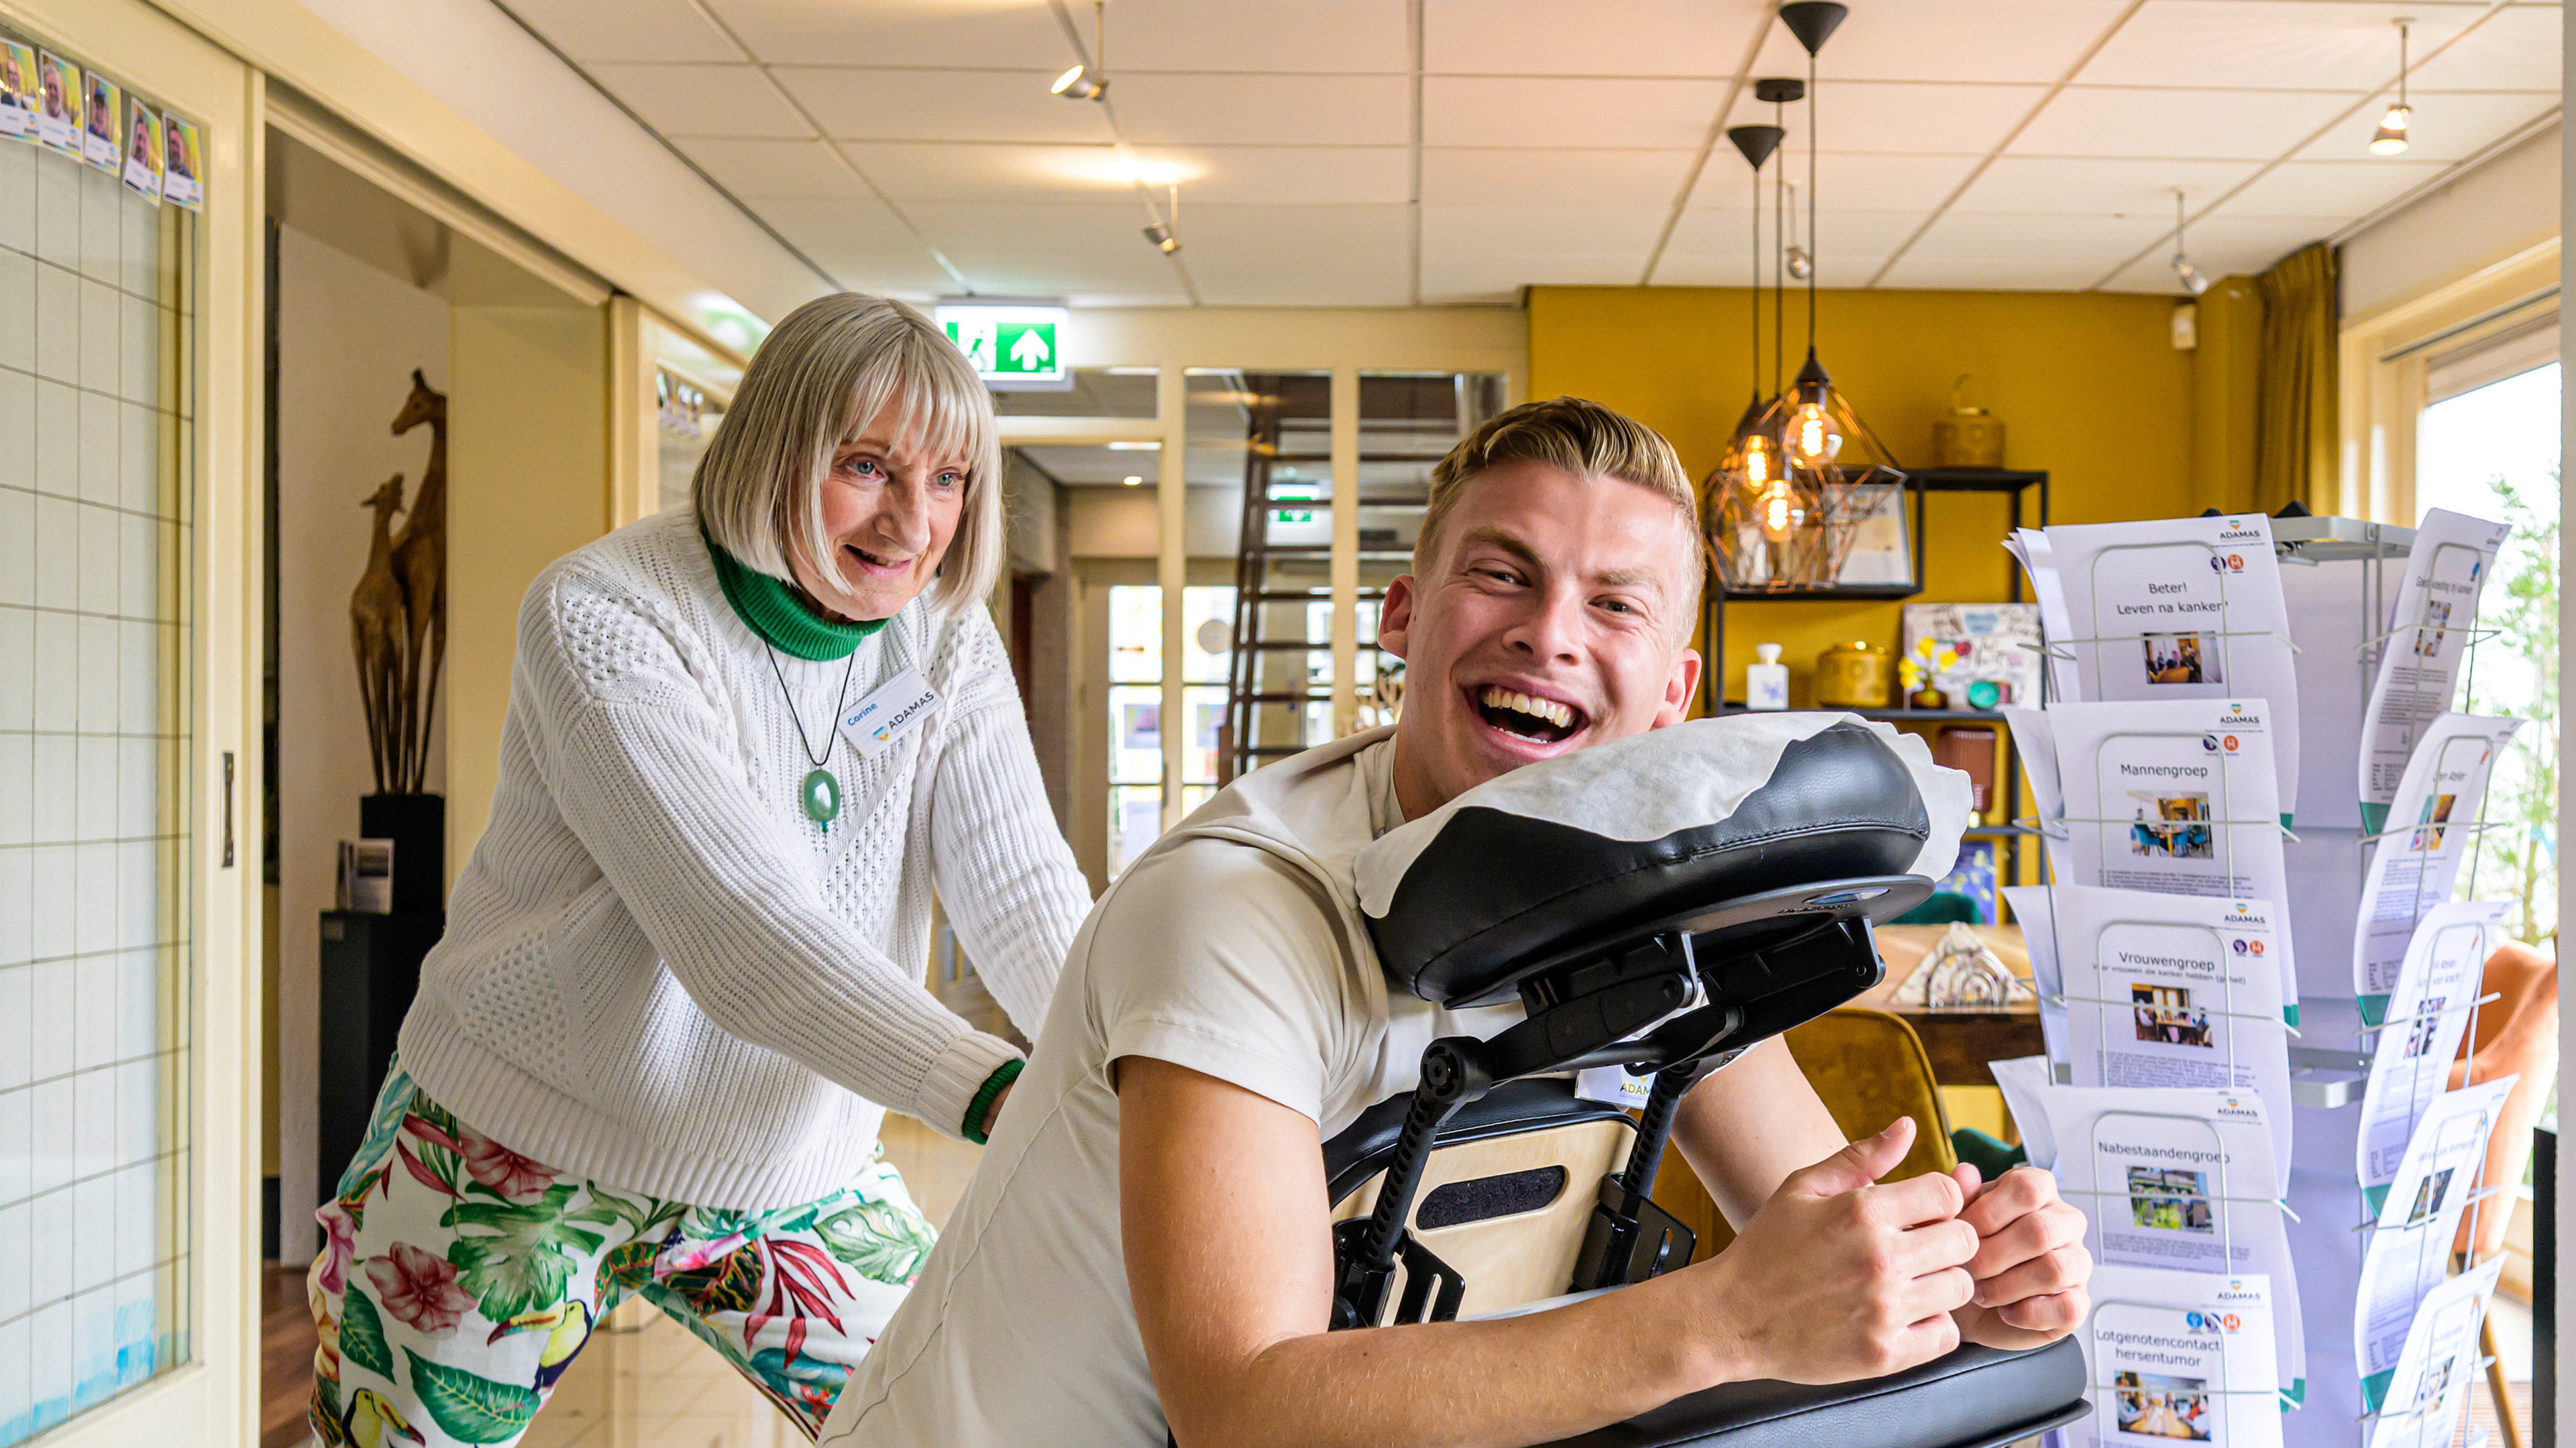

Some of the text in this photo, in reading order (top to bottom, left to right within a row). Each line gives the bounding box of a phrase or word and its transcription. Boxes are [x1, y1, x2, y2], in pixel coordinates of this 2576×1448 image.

[2219, 530, 2260, 539] ADAMAS
[2148, 581, 2188, 594] Beter!
[2117, 600, 2228, 615] Leven na kanker
[847, 704, 877, 726] Corine
[888, 691, 934, 730] ADAMAS
[2220, 716, 2260, 724] ADAMAS
[2121, 764, 2208, 779] Mannengroep
[2224, 914, 2266, 924] ADAMAS
[2118, 950, 2215, 972] Vrouwengroep
[2218, 1292, 2261, 1301] ADAMAS
[2096, 1329, 2220, 1352] Lotgenotencontact
[2116, 1347, 2202, 1367] hersentumor
